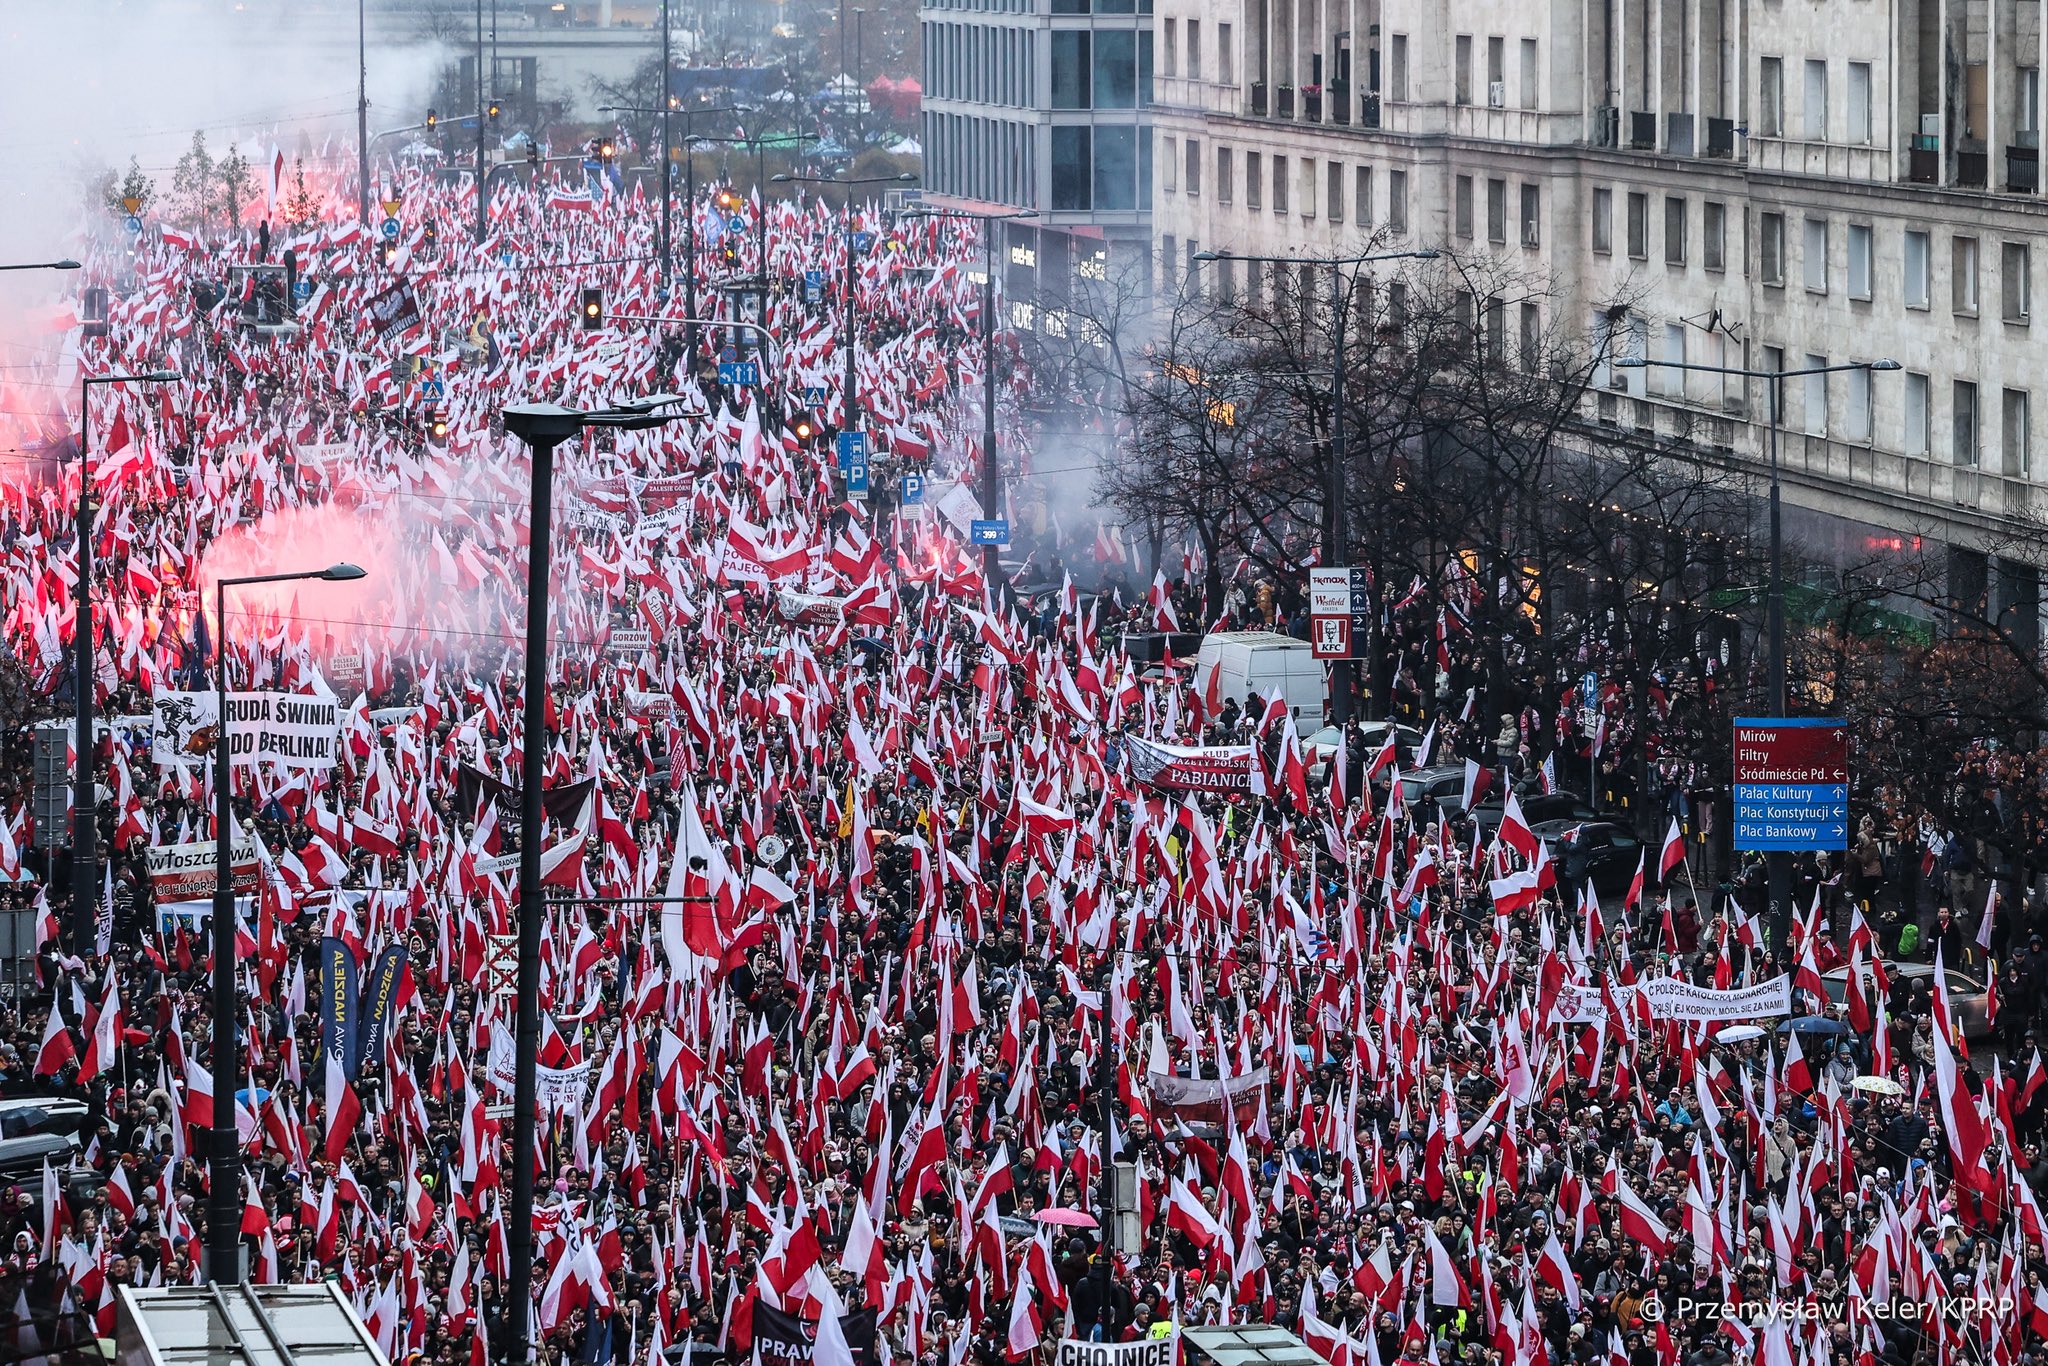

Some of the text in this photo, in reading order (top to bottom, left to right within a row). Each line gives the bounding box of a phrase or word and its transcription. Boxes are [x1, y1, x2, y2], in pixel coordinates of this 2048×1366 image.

[851, 466, 864, 483] P
[906, 478, 919, 497] P
[983, 531, 997, 540] 399
[1315, 595, 1346, 606] Westfield
[613, 631, 648, 642] GORZÓW
[1321, 643, 1341, 651] KFC
[1586, 674, 1594, 697] P
[225, 697, 336, 726] RUDA ŚWINIA
[1740, 730, 1777, 742] Mirów
[230, 732, 329, 759] DO BERLINA!
[1740, 749, 1769, 764] Filtry
[1214, 760, 1251, 769] POLSKI
[1740, 766, 1828, 780] Śródmieście Pd.
[1740, 787, 1813, 802] Pałac Kultury
[1740, 806, 1829, 821] Plac Konstytucji
[1740, 824, 1817, 839] Plac Bankowy
[156, 884, 171, 896] ÓG
[373, 954, 398, 1020] NADZIEJA
[1753, 1002, 1763, 1012] ZA
[1061, 1342, 1169, 1366] CHOJNICE
